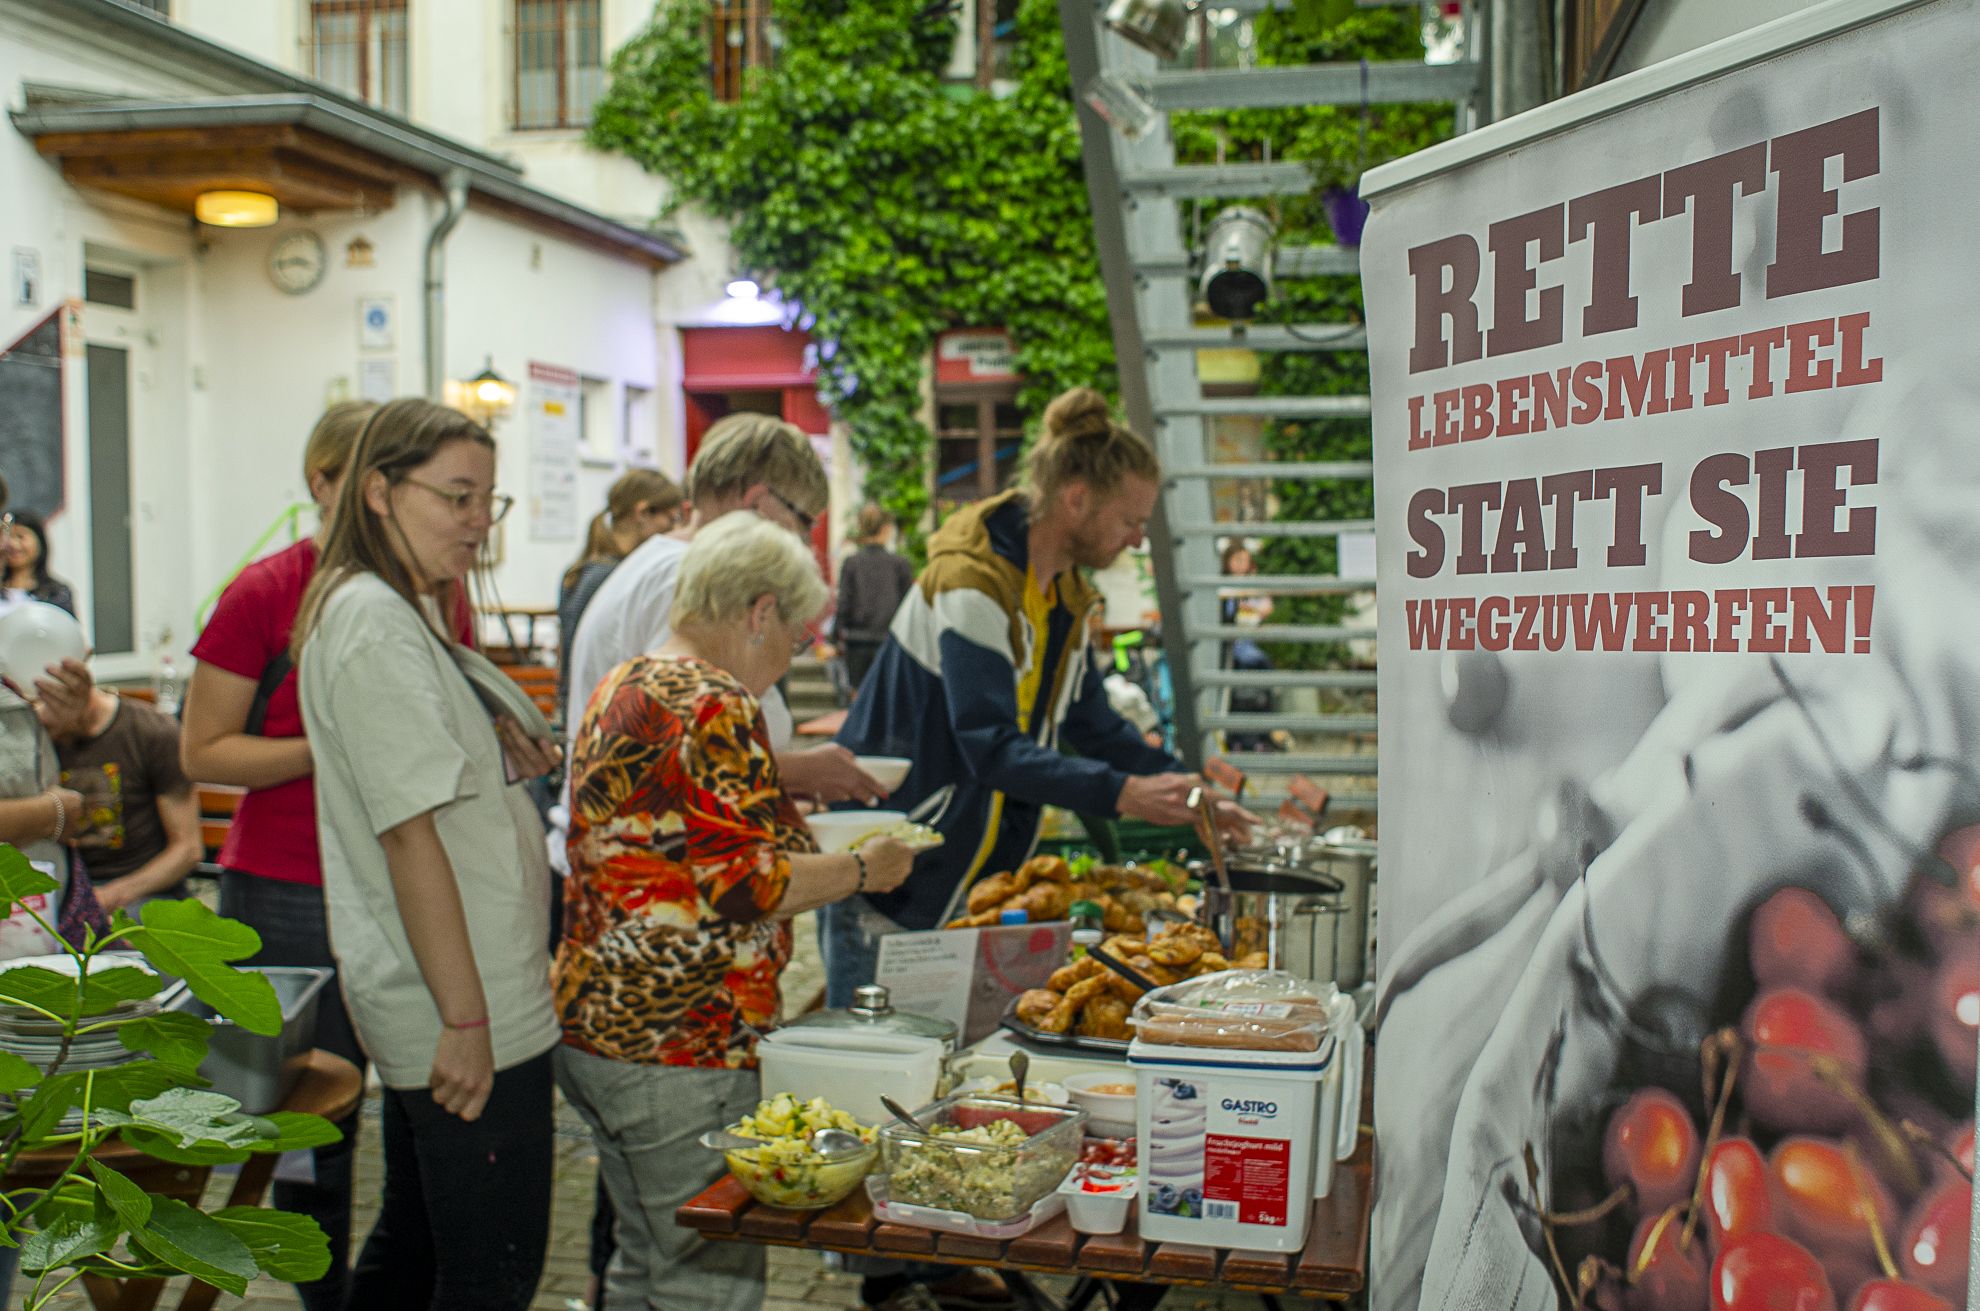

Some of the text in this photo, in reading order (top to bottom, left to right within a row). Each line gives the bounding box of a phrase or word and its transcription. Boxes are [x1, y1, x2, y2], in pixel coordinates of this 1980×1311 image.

[1408, 106, 1880, 375] RETTE
[1407, 311, 1883, 451] LEBENSMITTEL
[1406, 438, 1880, 578] STATT SIE
[1405, 585, 1876, 654] WEGZUWERFEN!
[1221, 1098, 1277, 1114] GASTRO
